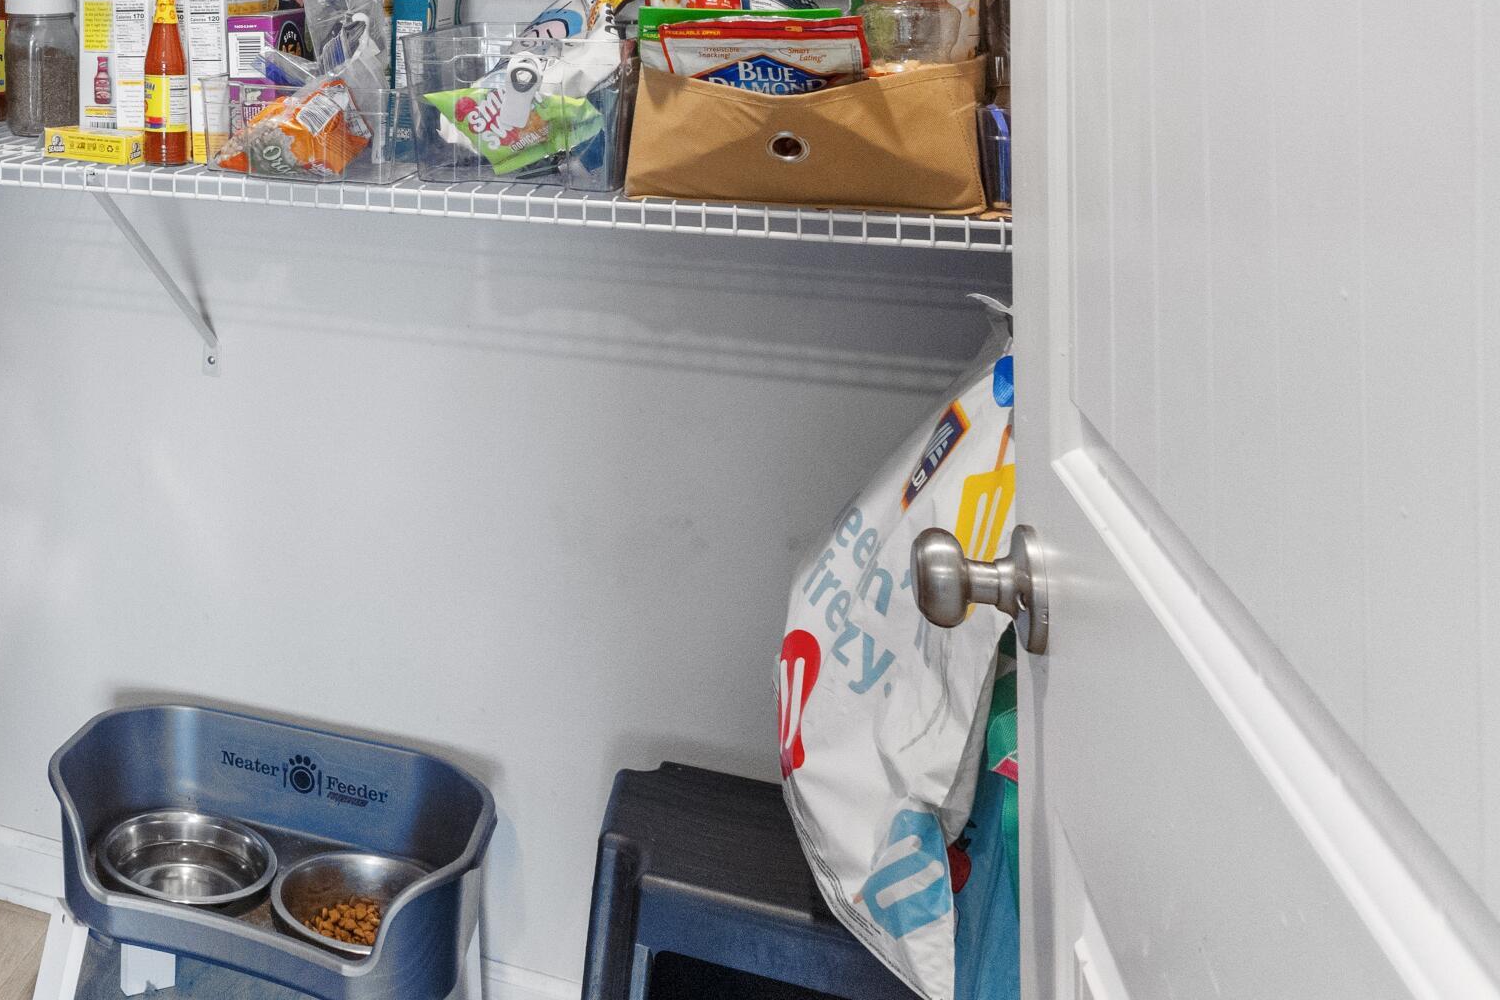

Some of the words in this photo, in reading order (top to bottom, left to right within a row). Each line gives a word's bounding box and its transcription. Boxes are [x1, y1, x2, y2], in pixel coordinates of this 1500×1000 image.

[788, 47, 810, 55] Smart
[738, 61, 795, 83] BLUE
[834, 505, 894, 618] een
[221, 750, 280, 778] Neater
[325, 775, 389, 803] Feeder
